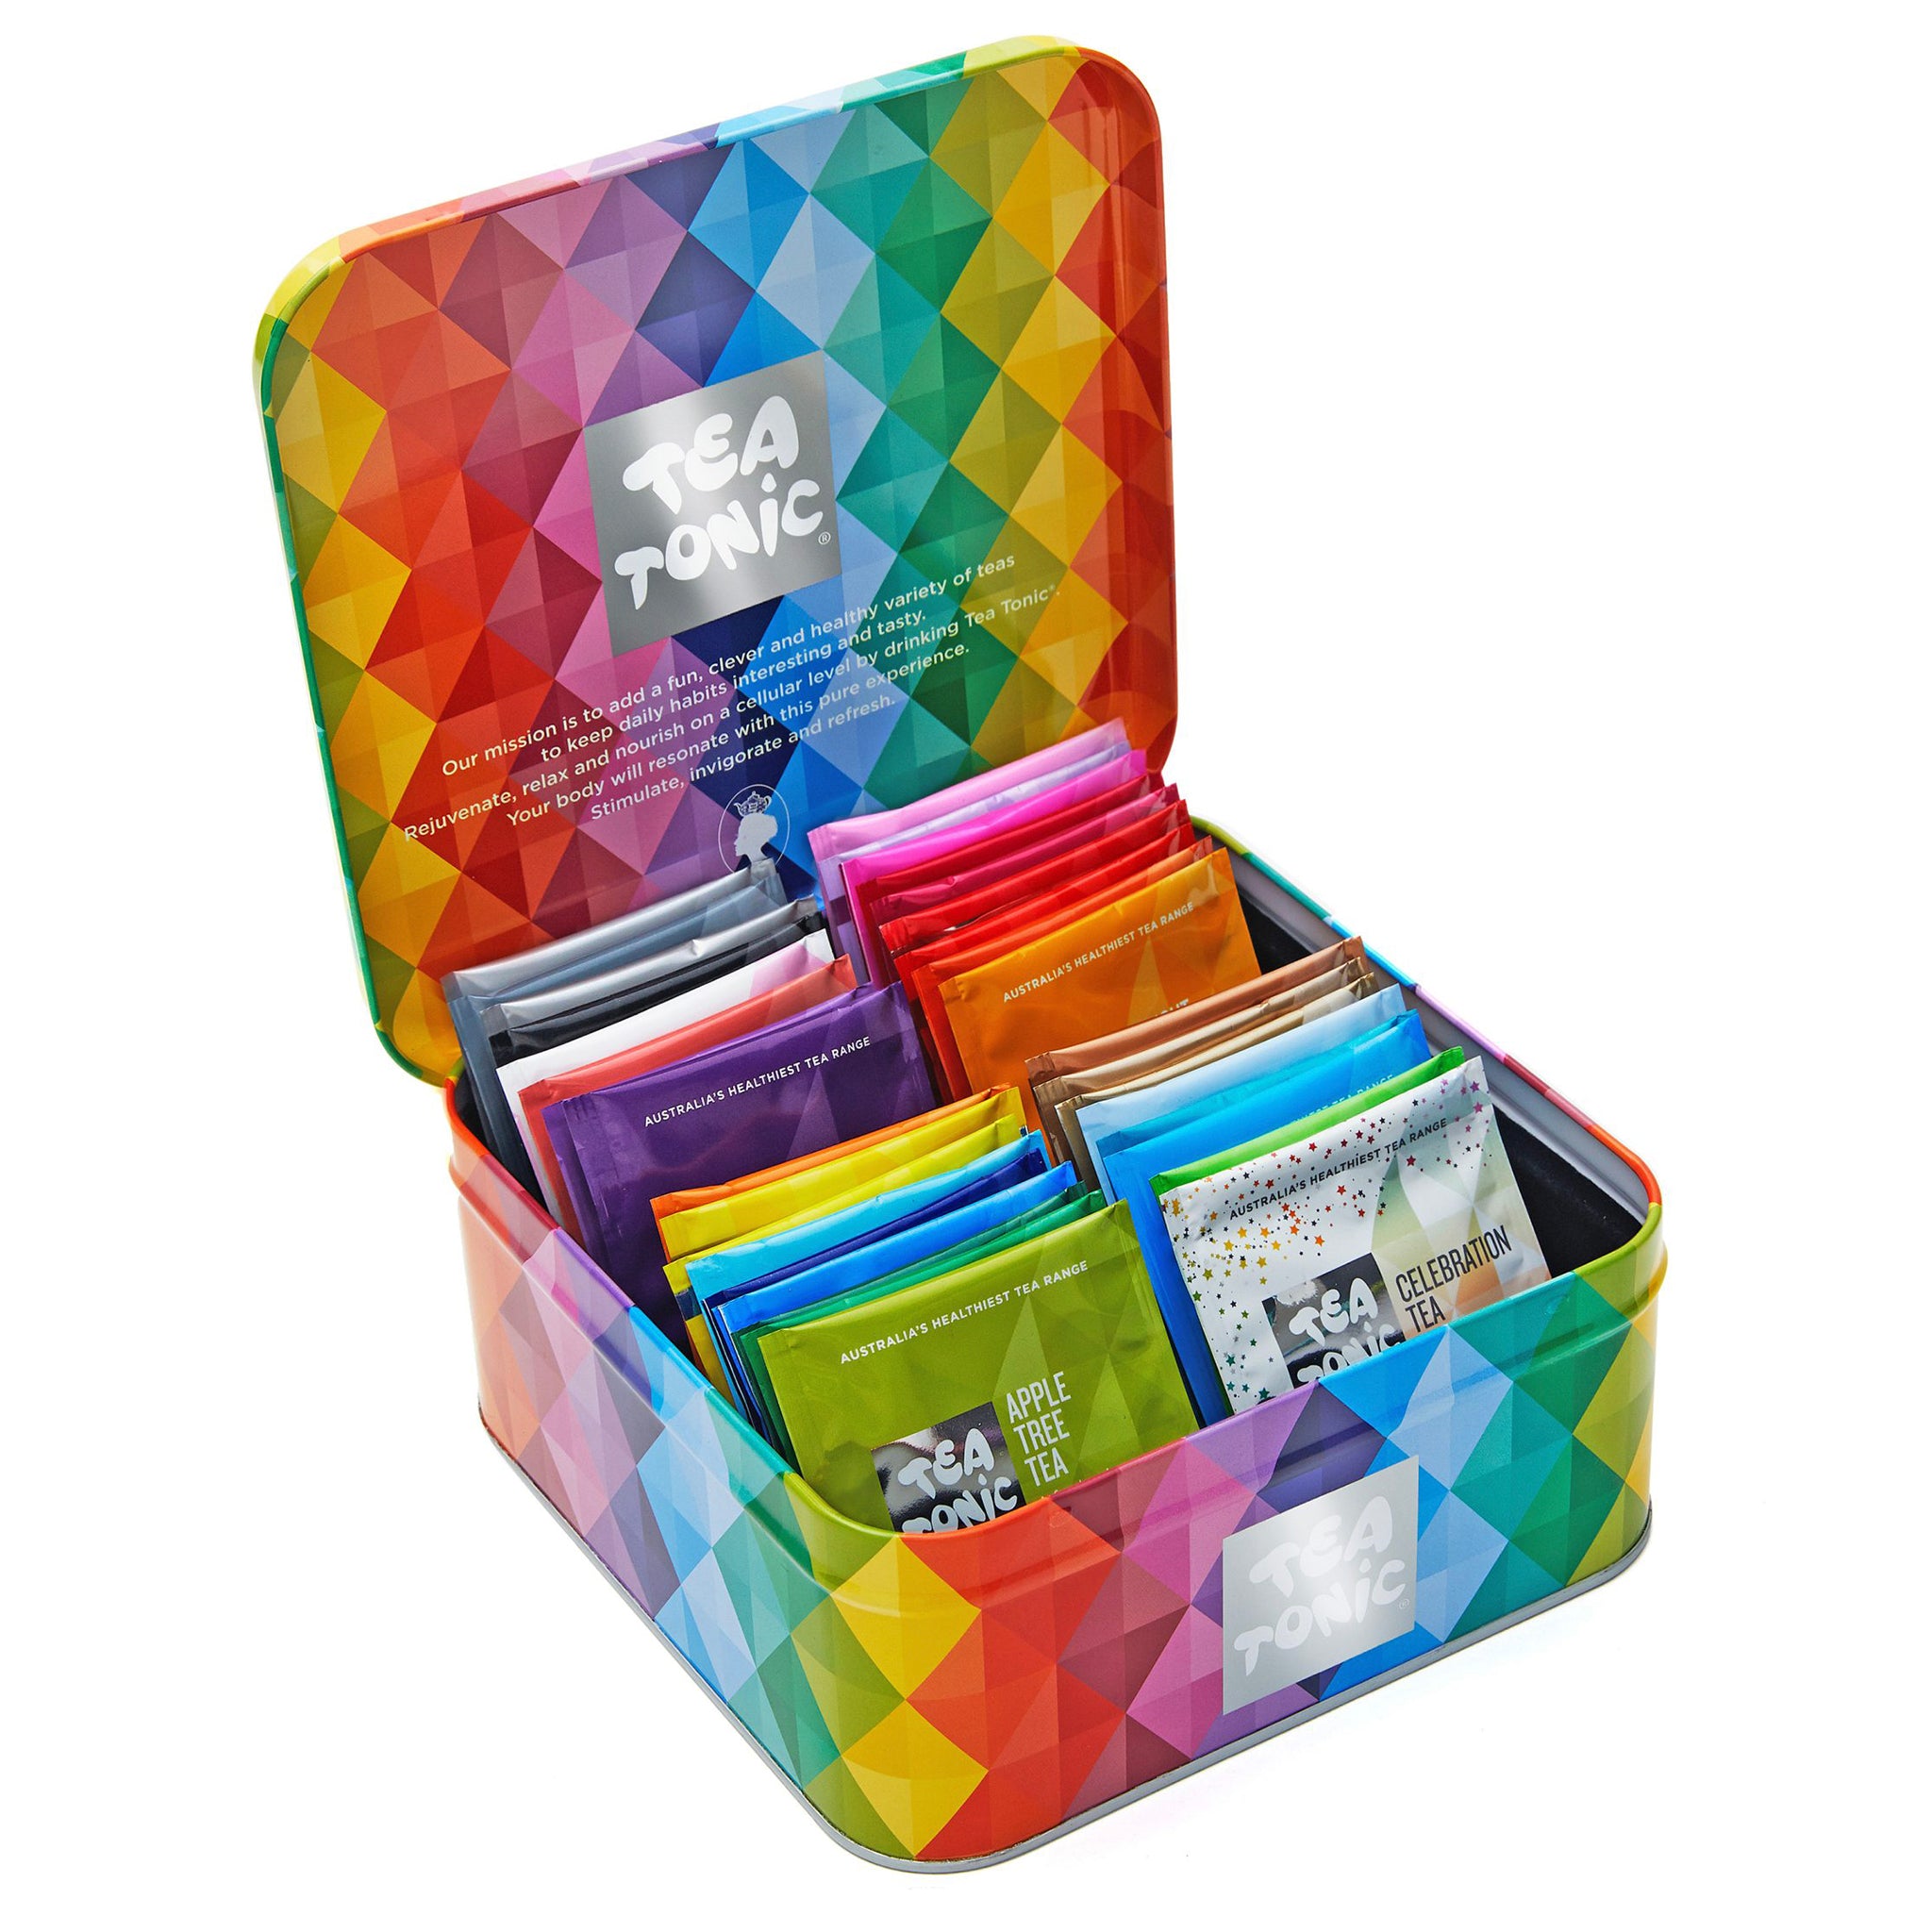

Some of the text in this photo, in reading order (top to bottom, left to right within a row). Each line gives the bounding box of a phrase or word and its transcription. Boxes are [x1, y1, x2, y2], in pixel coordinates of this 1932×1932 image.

[623, 395, 799, 515] TEA
[442, 555, 1015, 776] Our mission is to add a fun, clever and healthy variety of teas
[541, 608, 926, 762] to keep daily habits interesting and tasty.
[403, 790, 517, 842] Rejuvenate,
[522, 769, 568, 796] relax
[575, 750, 609, 776] and
[615, 721, 685, 761] nourish
[690, 712, 714, 731] on
[720, 707, 730, 719] a
[736, 677, 803, 713] cellular
[808, 658, 850, 688] level
[856, 649, 878, 670] by
[884, 622, 958, 658] drinking
[963, 608, 996, 629] Tea
[506, 645, 970, 827] Your body will resonate with this pure experience.
[591, 693, 896, 821] Stimulate, invigorate and refresh.
[1003, 901, 1194, 1003] AUSTRALIA'S HEALTHIEST TEA RANGE
[644, 1036, 871, 1127] AUSTRALIA'S HEALTHIEST TEA RANGE
[1229, 1118, 1448, 1220] AUSTRALIA'S HEALTHIEST TEA RANGE
[841, 1259, 1088, 1364] AUSTRALIA'S HEALTHIEST TEA RANGE
[1289, 1277, 1378, 1347] TEA
[1395, 1224, 1512, 1303] CELEBRATION
[1406, 1295, 1446, 1332] TEA
[1006, 1371, 1072, 1424] APPLE
[1013, 1408, 1071, 1455] TREE
[897, 1427, 995, 1500] TEA
[1024, 1447, 1069, 1487] TEA
[1249, 1496, 1393, 1598] TEA
